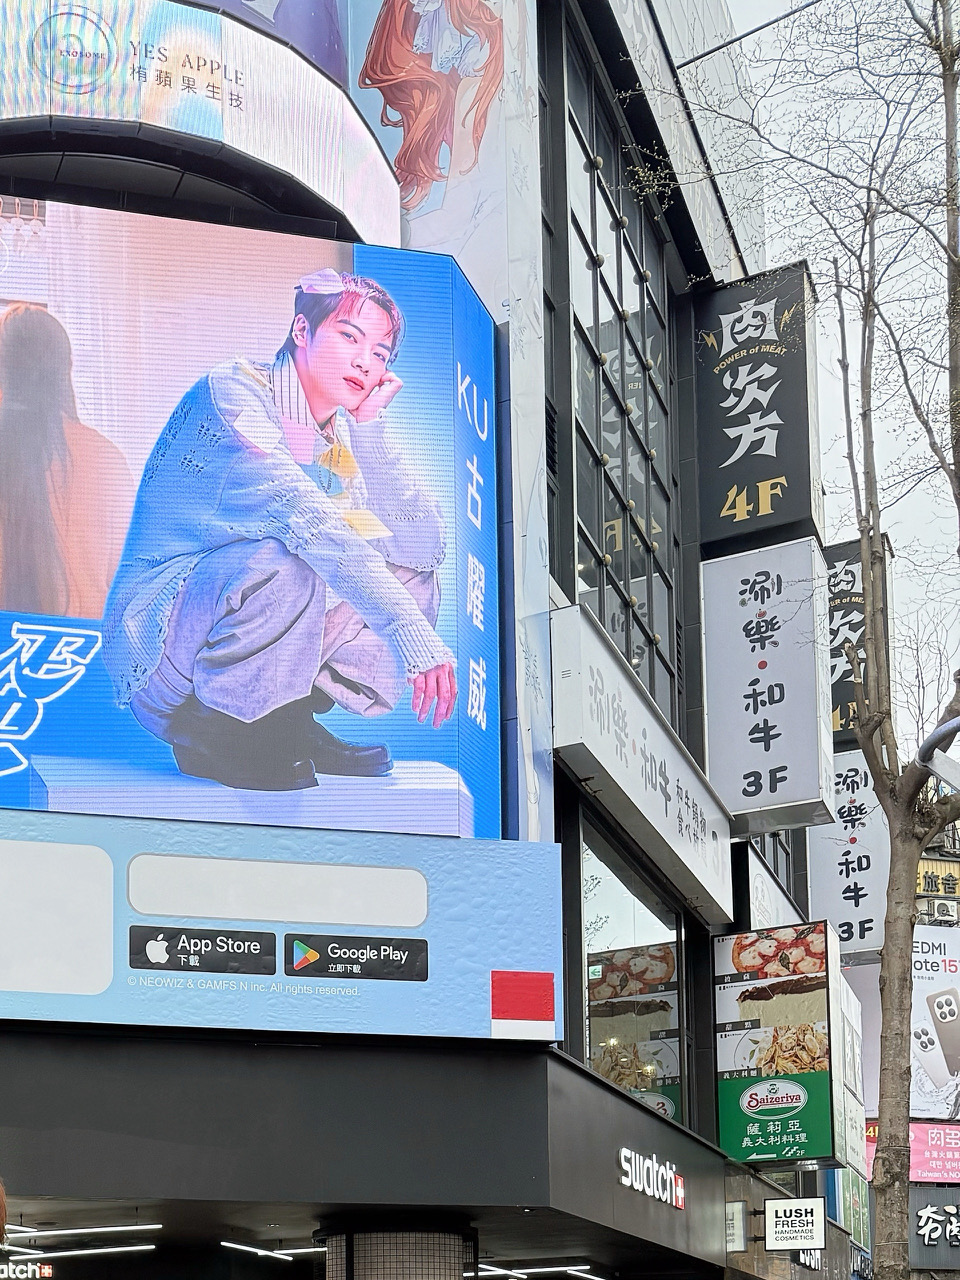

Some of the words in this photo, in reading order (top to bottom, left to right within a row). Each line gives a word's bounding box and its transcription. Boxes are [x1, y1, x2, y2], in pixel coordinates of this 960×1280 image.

[129, 40, 168, 63] YES
[181, 54, 245, 87] APPLE
[713, 348, 748, 375] POWER
[749, 346, 760, 355] of
[760, 343, 788, 356] MEAT
[719, 475, 788, 522] 4F
[741, 765, 788, 798] 3F
[838, 918, 874, 942] 3F
[177, 935, 213, 953] App
[215, 936, 261, 955] Store
[327, 943, 379, 963] Google
[380, 945, 409, 964] Play
[912, 941, 947, 955] EDMI
[177, 954, 200, 967] 下載
[327, 963, 362, 975] 立即下載
[913, 958, 940, 972] ote
[941, 958, 960, 973] 15
[139, 976, 184, 989] NEOWIZ
[186, 979, 194, 989] &
[269, 981, 283, 993] All
[284, 982, 314, 998] rights
[315, 985, 361, 997] reserved.
[745, 1092, 802, 1110] Saizeriya
[746, 1119, 803, 1136] 薩莉亞
[741, 1132, 809, 1148] 義大利料理
[619, 1147, 677, 1208] swatch
[774, 1208, 814, 1219] LUSH
[774, 1218, 814, 1229] FRESH
[774, 1228, 814, 1236] HANDMADE
